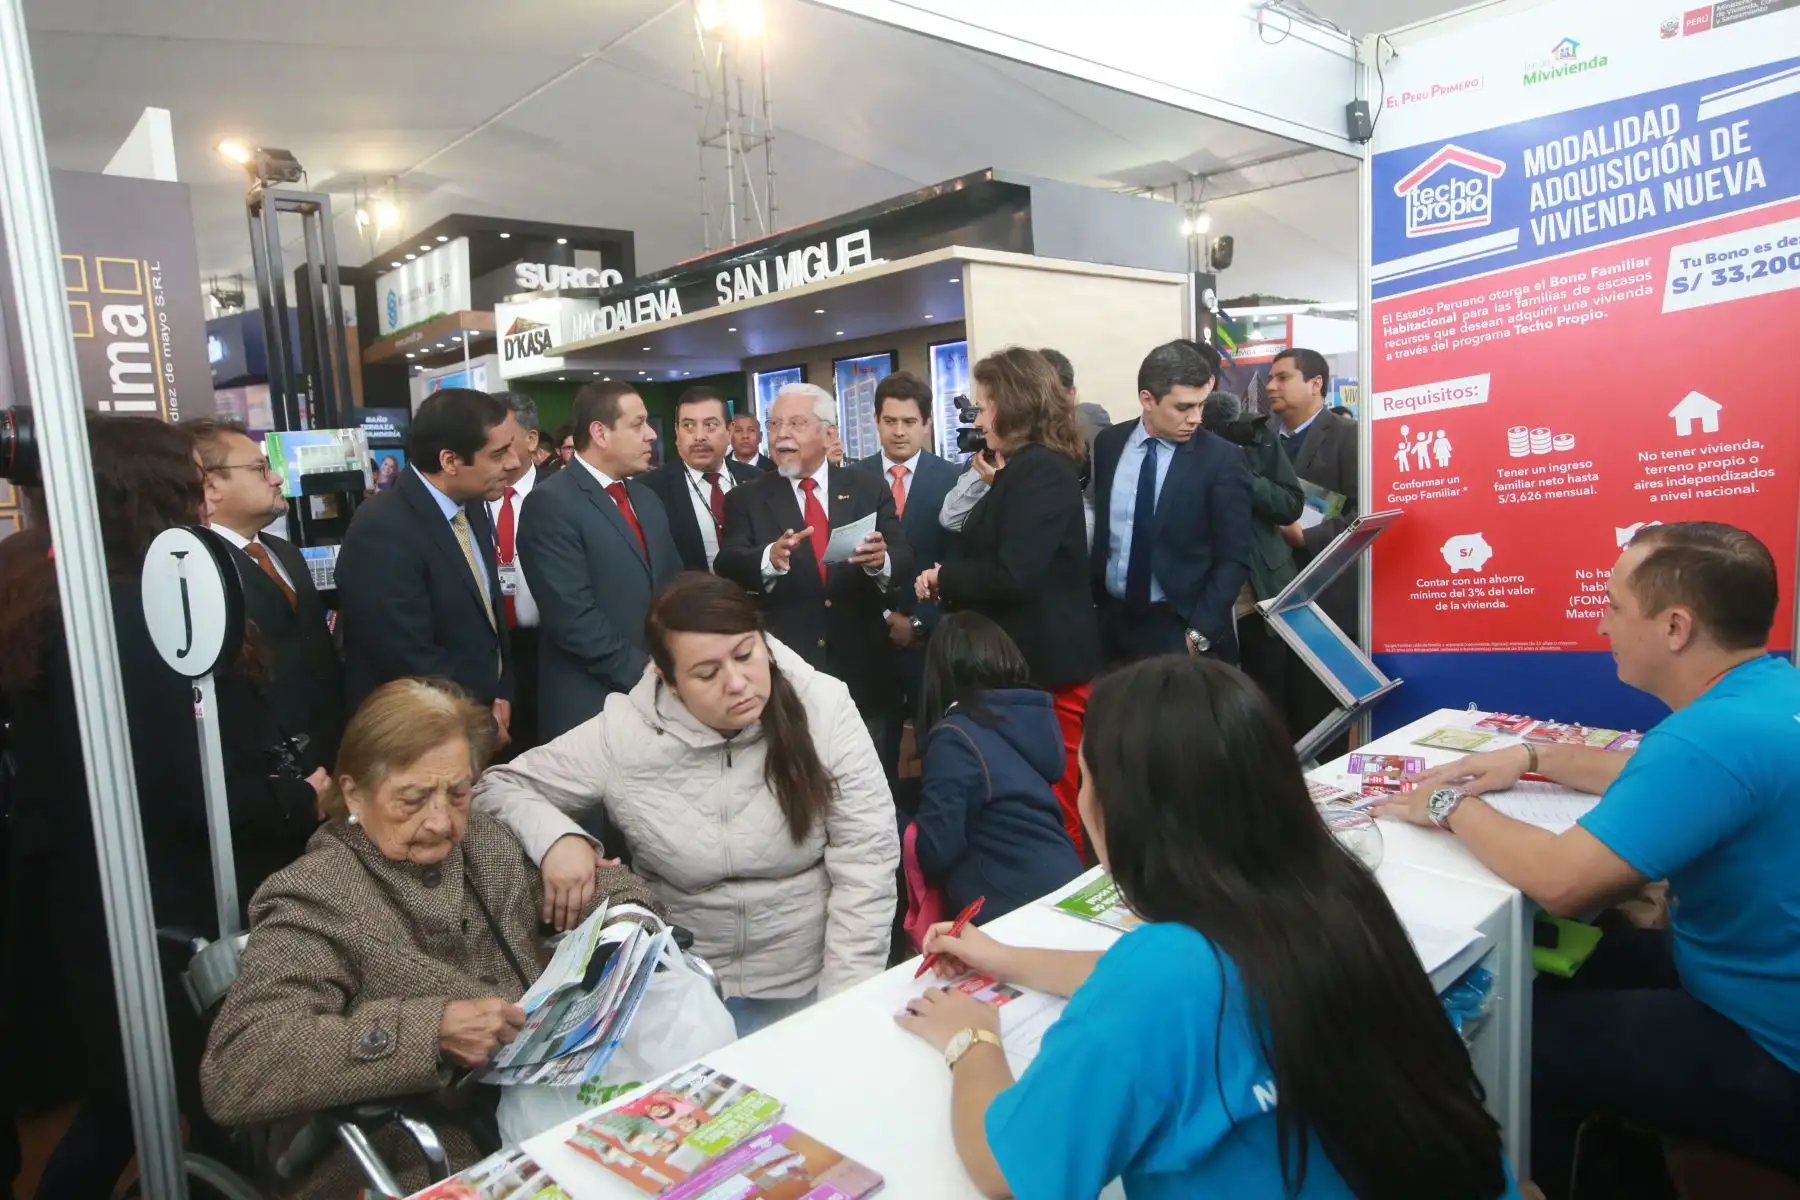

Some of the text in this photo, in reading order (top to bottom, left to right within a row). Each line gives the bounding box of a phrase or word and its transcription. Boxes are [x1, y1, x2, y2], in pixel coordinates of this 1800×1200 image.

[1686, 14, 1709, 27] PERÚ
[1523, 56, 1608, 87] Mivivienda
[1523, 103, 1681, 178] MODALIDAD
[1530, 119, 1752, 213] ADQUISICIÓN DE
[1410, 177, 1483, 207] techo
[1530, 156, 1768, 246] VIVIENDA NUEVA
[1412, 193, 1489, 229] propio
[1680, 257, 1702, 270] Tu
[1705, 247, 1749, 265] Bono
[1753, 242, 1772, 254] es
[515, 262, 623, 291] SURCO
[716, 229, 890, 306] SAN MIGUEL
[1382, 256, 1651, 325] El Estado Peruano otorga el Bono Familiar
[1671, 272, 1703, 294] S/
[572, 287, 683, 342] MAGDALENA
[1383, 272, 1652, 337] Habitacional para las familias de escasos
[1385, 284, 1653, 349] recursos que desean adquirir una vivienda
[159, 312, 171, 358] mayo
[1386, 309, 1608, 361] a través del programa Techo Propio.
[165, 363, 175, 383] de
[169, 388, 180, 421] diez
[1344, 386, 1358, 403] VIV
[1383, 385, 1479, 411] Requisitos:
[1638, 439, 1764, 462] No tener vivienda,
[1497, 460, 1593, 479] Tener un ingreso
[1645, 455, 1759, 475] terreno propio o
[1392, 476, 1460, 491] Conformar un
[1493, 472, 1599, 492] familiar neto hasta
[1633, 468, 1775, 490] aires independizados
[1387, 488, 1460, 504] Grupo Familiar
[1498, 486, 1597, 504] S/3,626 mensual.
[1650, 483, 1759, 503] a nivel nacional.
[1459, 547, 1474, 558] S/
[1416, 574, 1525, 588] Contar con un ahorro
[1575, 569, 1593, 579] No
[1410, 586, 1535, 600] mínimo del 3% del valor
[1581, 582, 1607, 592] habi
[170, 551, 192, 658] J
[1435, 599, 1509, 610] de la vivienda.
[1569, 596, 1611, 607] (FONA
[1566, 608, 1604, 619] Materi
[1253, 1080, 1277, 1112] N
